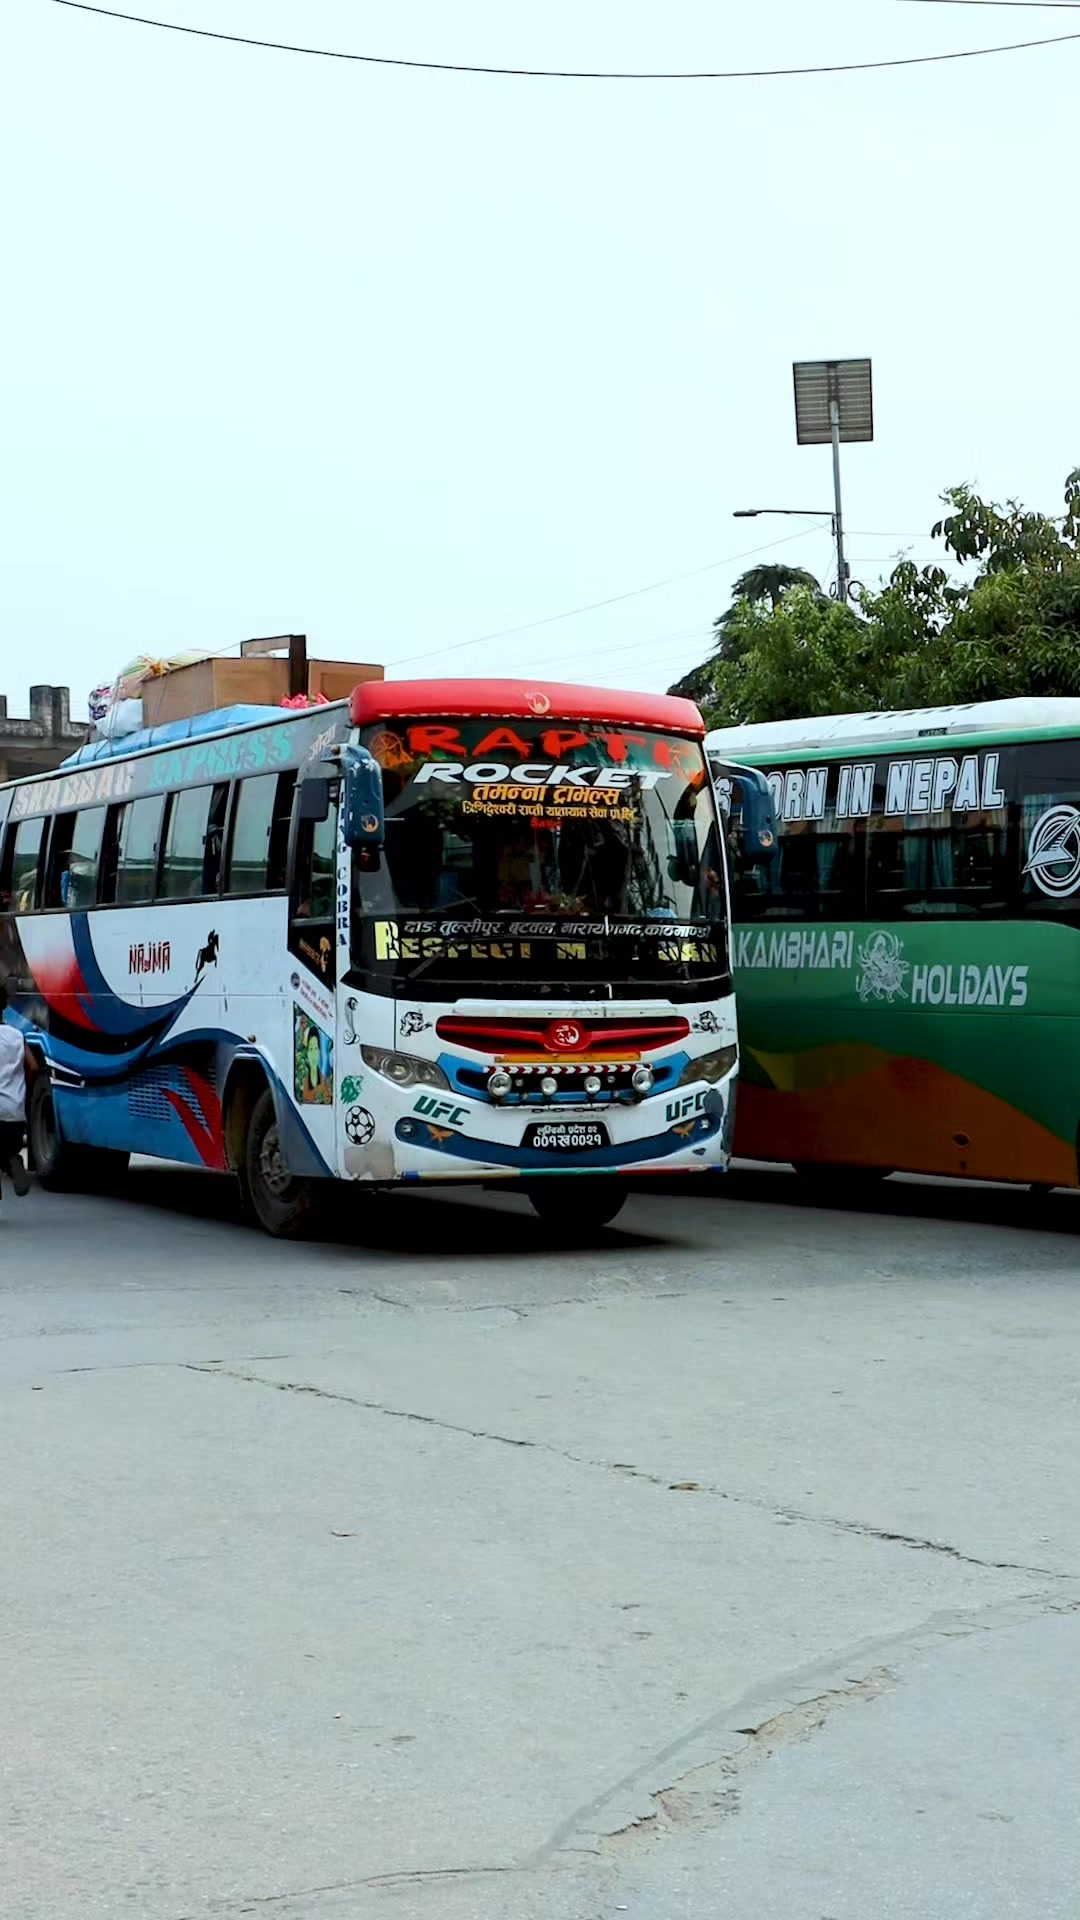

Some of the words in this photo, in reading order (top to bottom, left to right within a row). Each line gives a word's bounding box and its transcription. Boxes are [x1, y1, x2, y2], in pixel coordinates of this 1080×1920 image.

[149, 728, 295, 791] EXPRESS
[413, 762, 672, 790] ROCKET
[473, 784, 550, 801] तमन्ना
[740, 771, 828, 824] ORN
[836, 763, 876, 818] IN
[884, 753, 1005, 816] NEPAL
[337, 866, 350, 946] COBRA
[129, 940, 171, 974] NAJMA
[910, 964, 1029, 1006] HOLIDAYS
[412, 1095, 471, 1126] UFC
[664, 1091, 705, 1123] UFC
